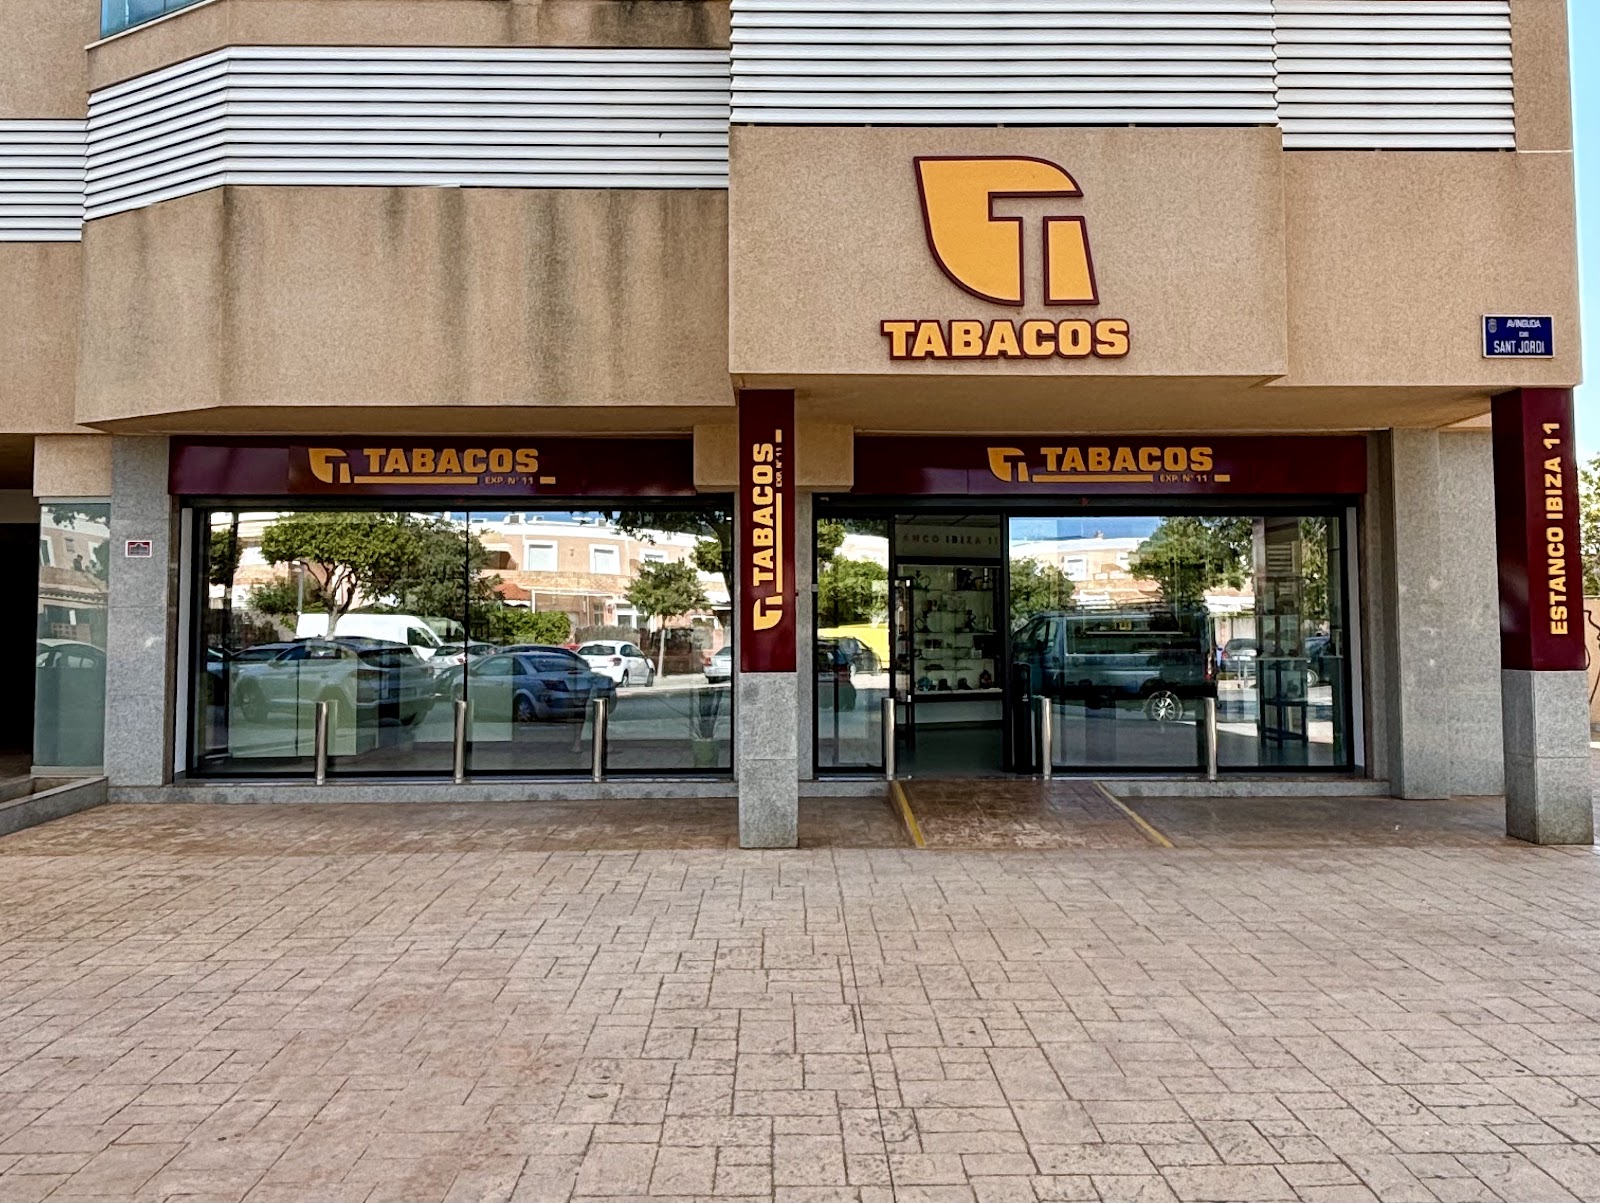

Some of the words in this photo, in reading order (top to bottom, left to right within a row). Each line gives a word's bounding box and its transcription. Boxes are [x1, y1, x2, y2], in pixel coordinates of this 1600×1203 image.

[880, 319, 1130, 360] TABACOS
[1493, 340, 1516, 353] SANT
[1518, 340, 1545, 353] JORDI
[1543, 423, 1561, 449] 11
[363, 448, 539, 473] TABACOS
[775, 447, 782, 457] 11
[1040, 447, 1213, 472] TABACOS
[522, 476, 533, 485] 11
[1196, 474, 1208, 483] 11
[1544, 457, 1564, 520] IBIZA
[753, 443, 774, 587] TABACOS
[945, 535, 981, 544] IBIZA
[1546, 527, 1568, 635] ESTANCO
